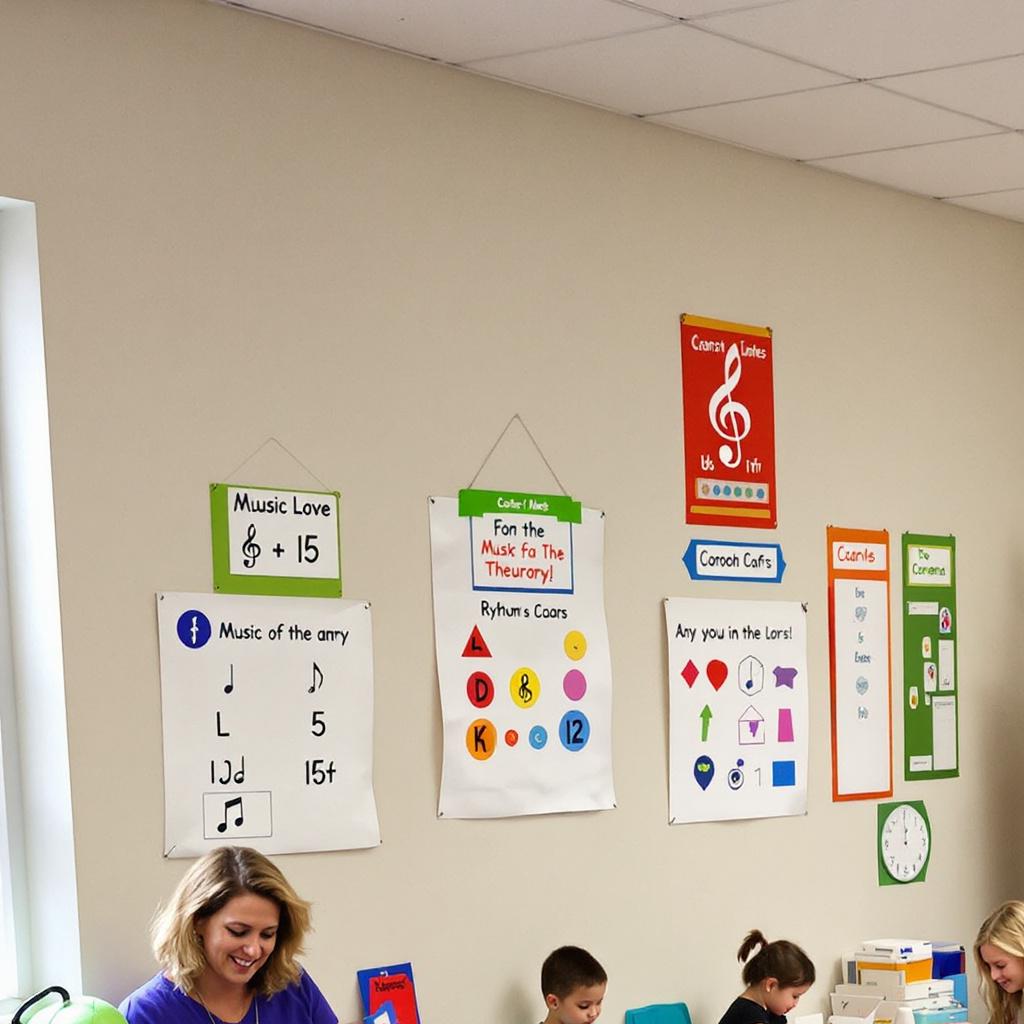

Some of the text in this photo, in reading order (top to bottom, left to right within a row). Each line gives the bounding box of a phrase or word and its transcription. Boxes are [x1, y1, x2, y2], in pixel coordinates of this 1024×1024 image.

[293, 496, 331, 517] Love
[522, 521, 545, 538] the
[298, 535, 319, 563] 15
[542, 544, 565, 560] The
[219, 622, 263, 640] Music
[268, 623, 284, 641] of
[288, 624, 312, 641] the
[675, 623, 696, 643] Any
[701, 628, 724, 643] you
[728, 625, 739, 640] in
[742, 625, 761, 640] the
[475, 679, 488, 702] D
[217, 711, 326, 737] L 5
[566, 719, 584, 744] 12
[474, 725, 486, 753] K
